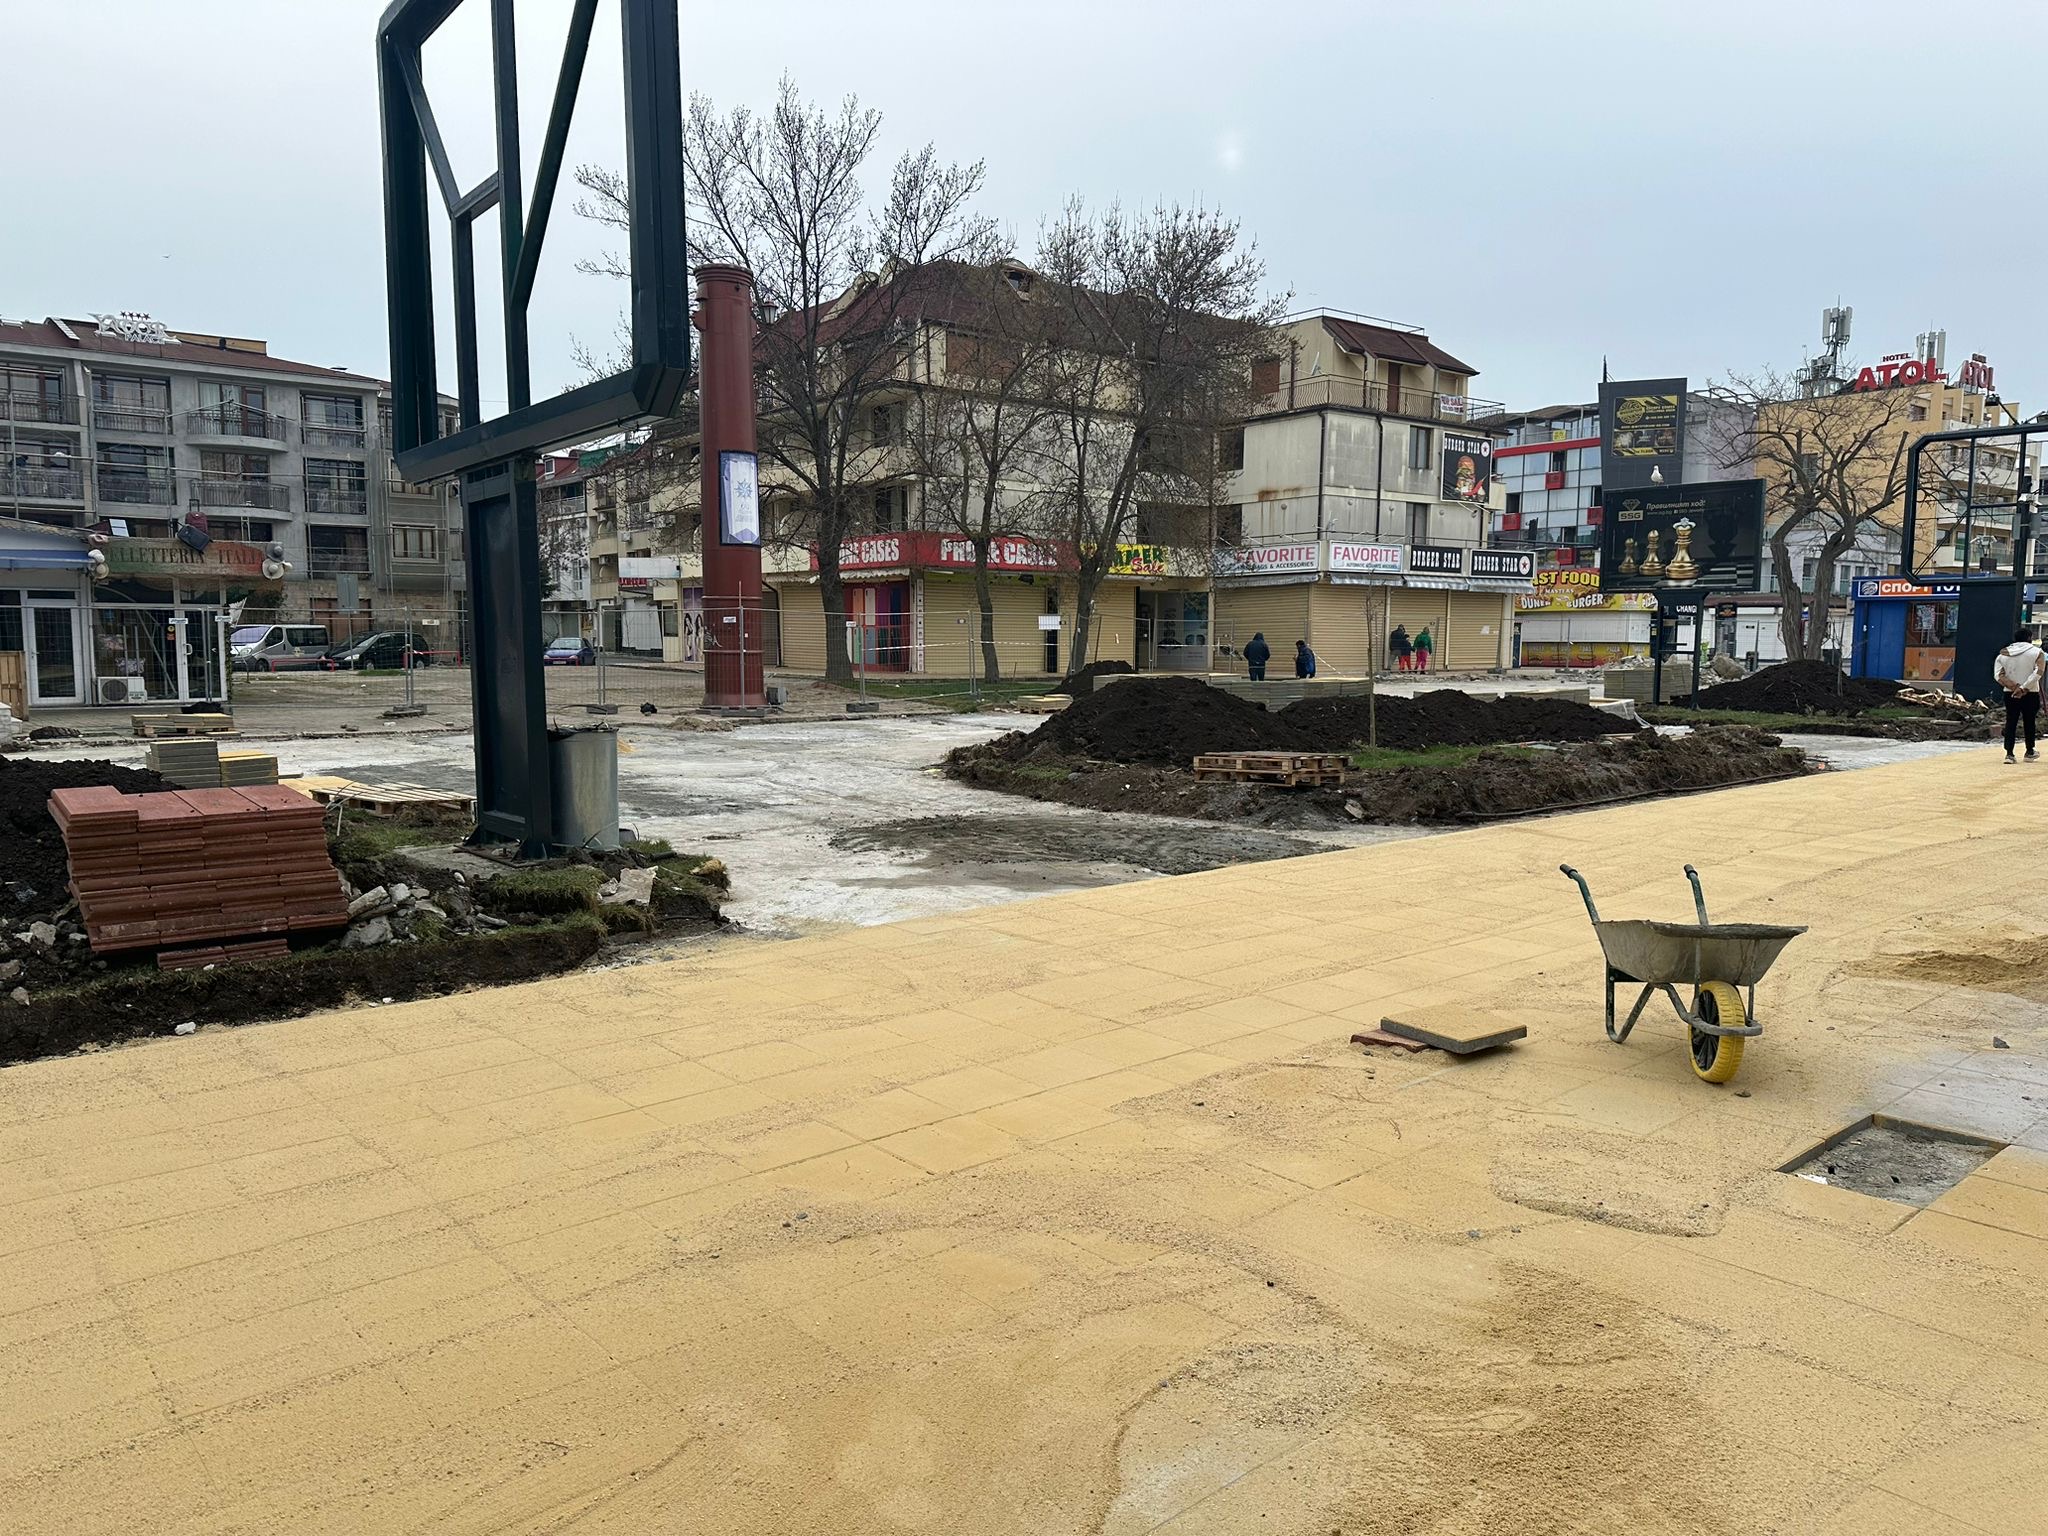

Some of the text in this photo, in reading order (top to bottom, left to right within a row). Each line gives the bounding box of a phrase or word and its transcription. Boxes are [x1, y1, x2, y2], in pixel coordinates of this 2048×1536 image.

[1882, 352, 1911, 362] HOTEL
[1854, 358, 1947, 392] ATOL
[1959, 360, 1996, 391] ATOL
[1444, 437, 1480, 454] BURGER STAR
[1620, 512, 1641, 520] SSG
[861, 538, 900, 563] CASES
[1237, 546, 1315, 564] FAVORITE
[1333, 546, 1399, 562] FAVORITE
[1132, 557, 1165, 574] Sale
[1276, 561, 1314, 569] ACCESSORIES
[1412, 550, 1461, 569] BURGER STAR
[1473, 555, 1518, 572] BURGER STAR
[1561, 571, 1600, 587] FOOD
[1566, 593, 1604, 608] BURGER
